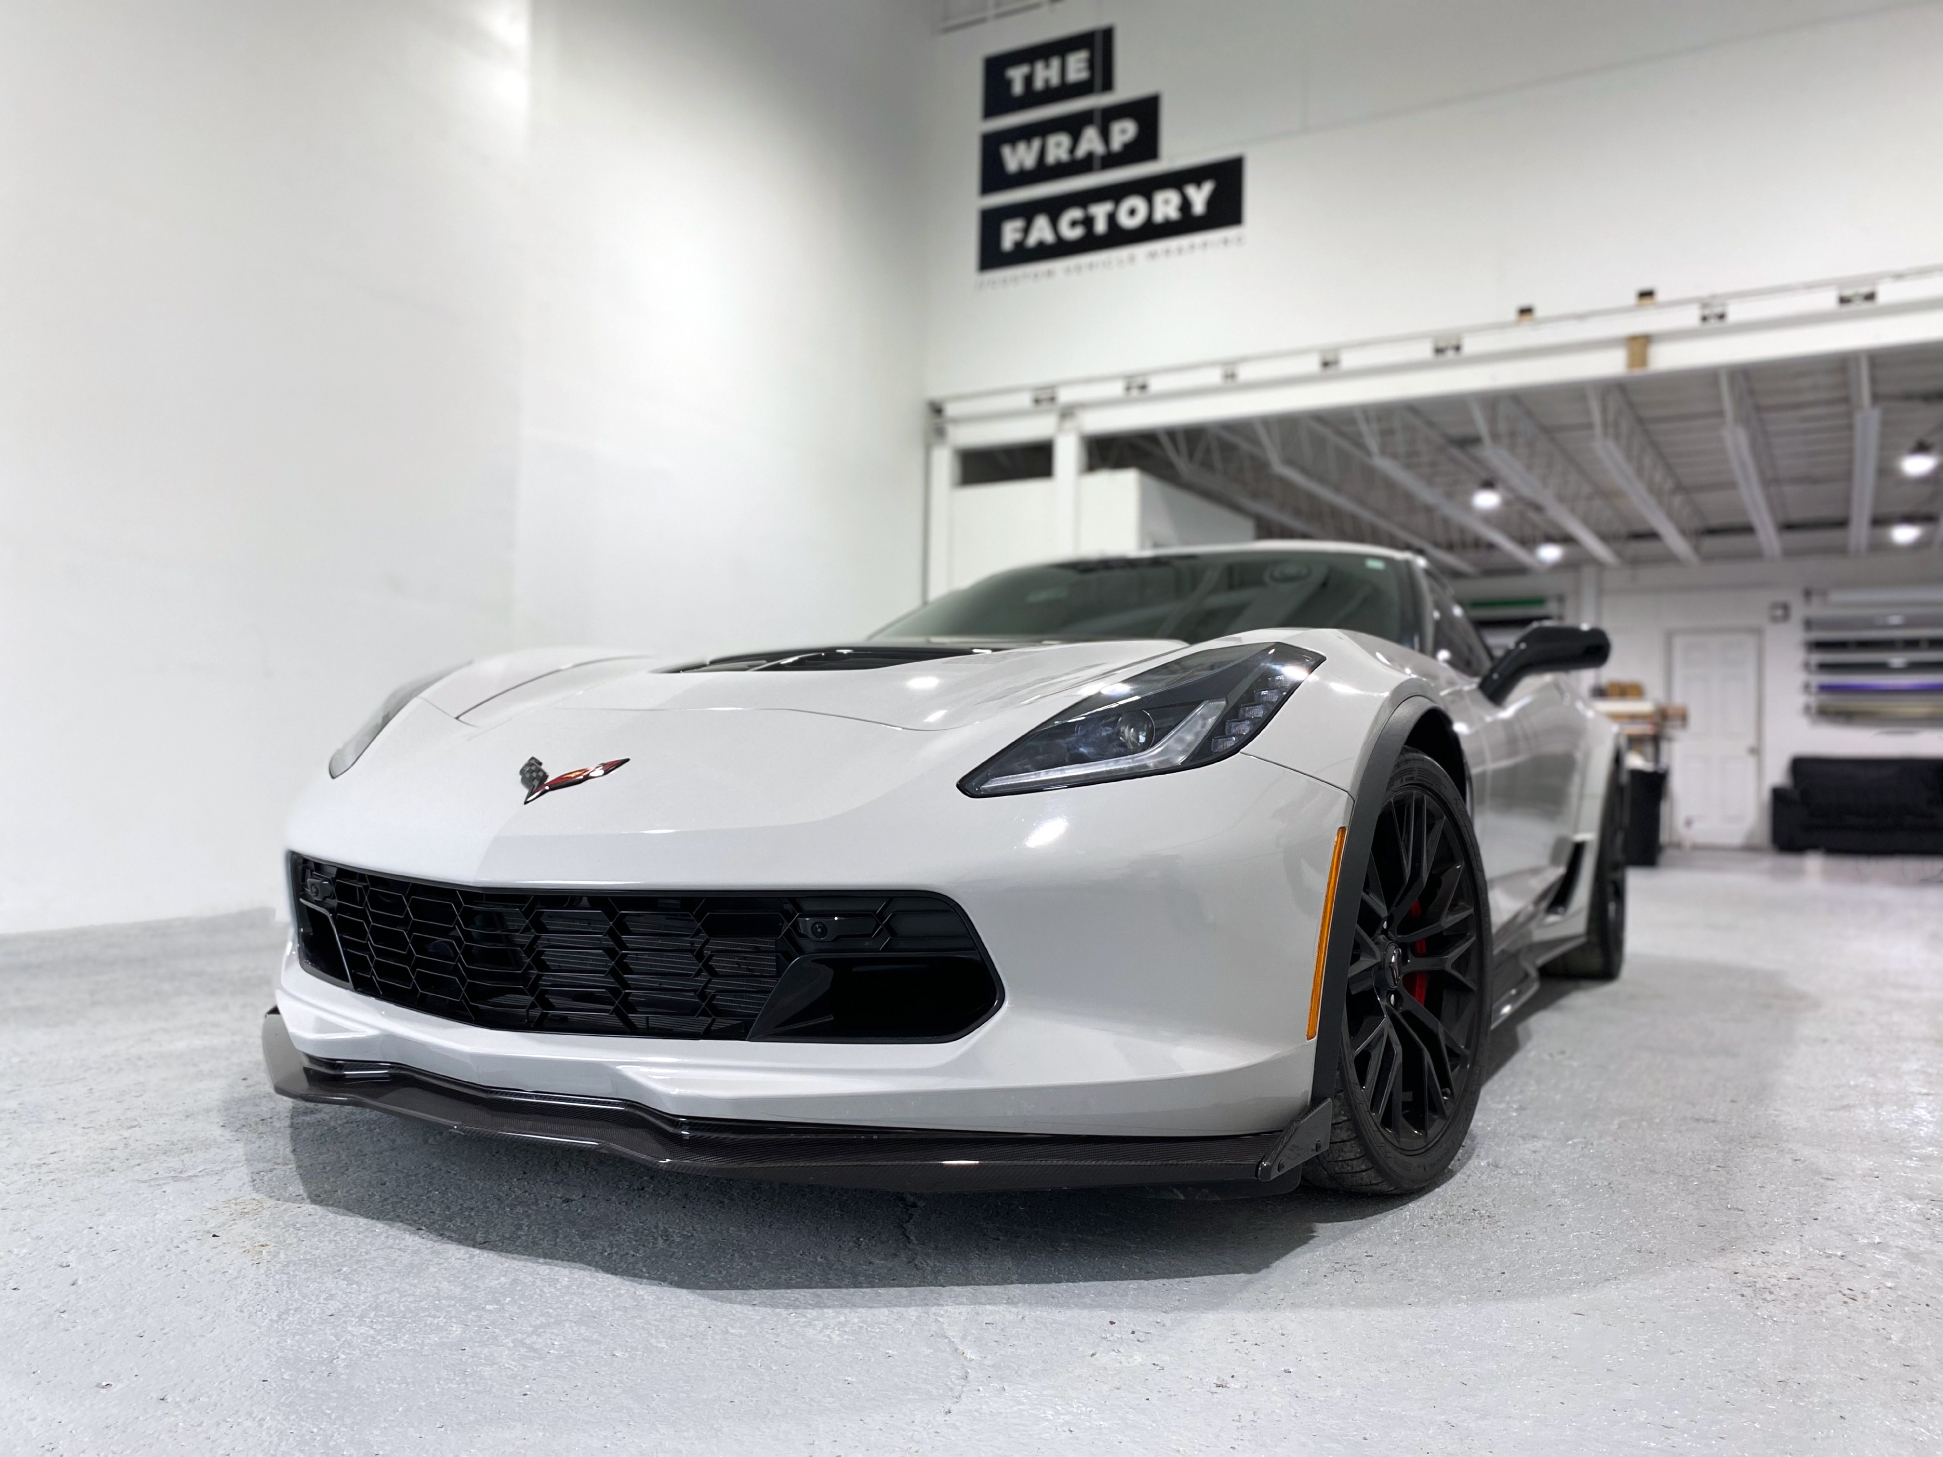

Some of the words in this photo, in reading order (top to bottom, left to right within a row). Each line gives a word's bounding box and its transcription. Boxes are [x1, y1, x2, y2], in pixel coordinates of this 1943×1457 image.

[1006, 50, 1090, 96] THE
[1001, 118, 1138, 173] WRAP
[1001, 180, 1215, 252] FACTORY
